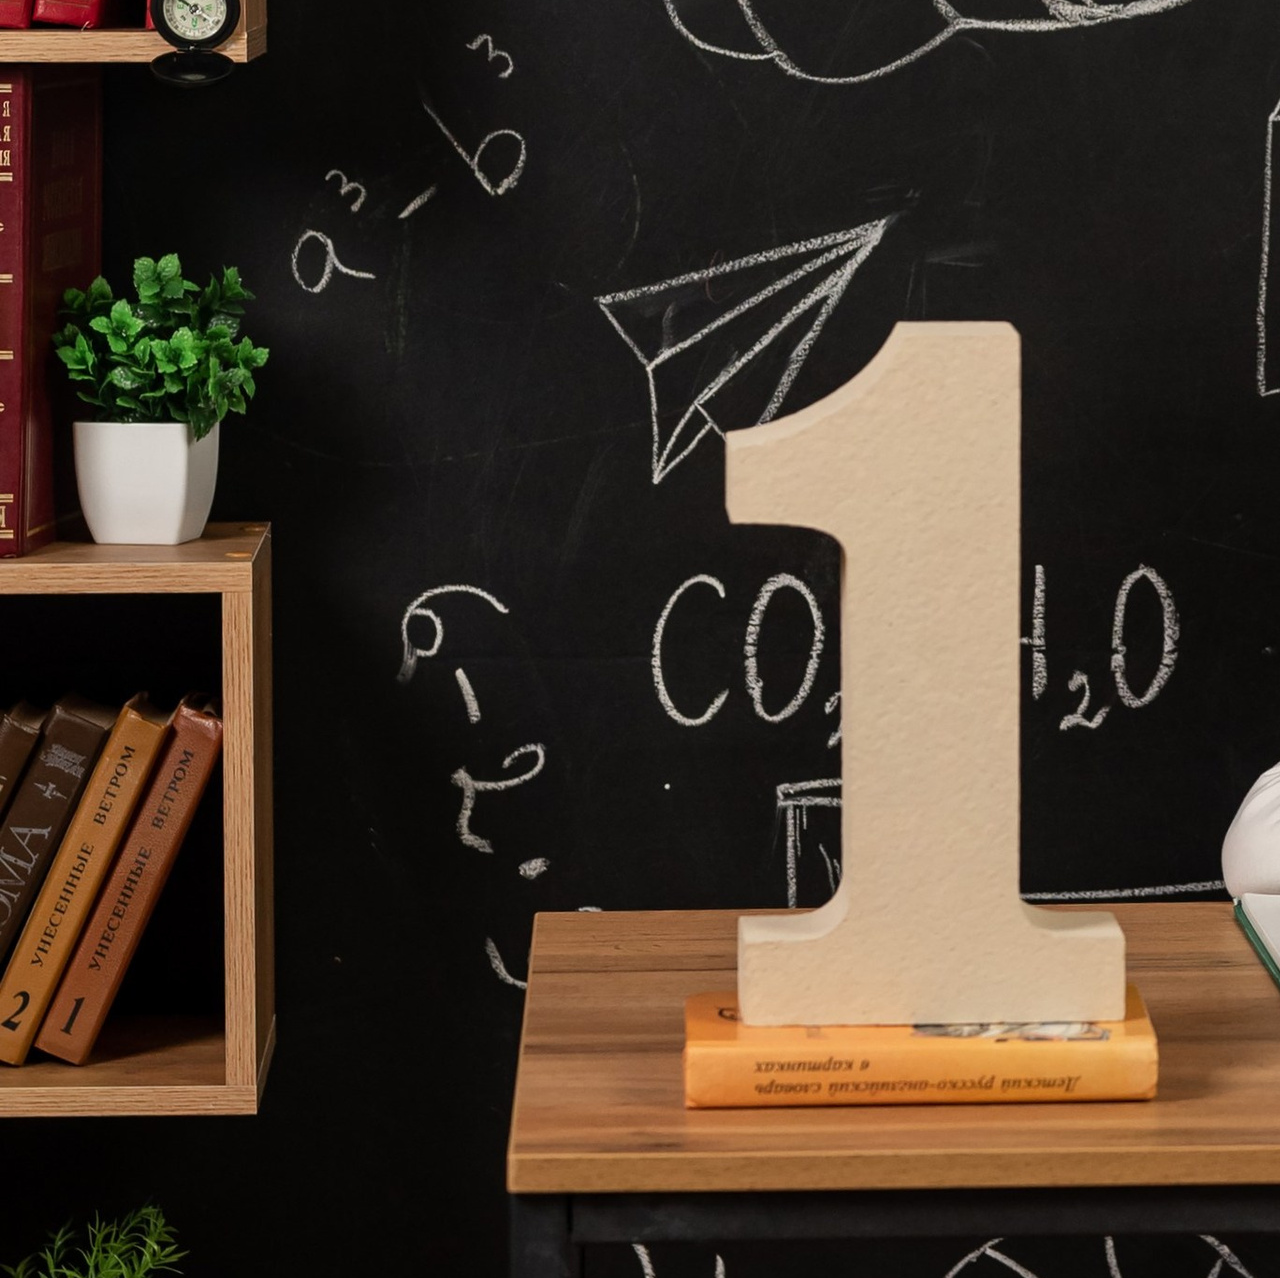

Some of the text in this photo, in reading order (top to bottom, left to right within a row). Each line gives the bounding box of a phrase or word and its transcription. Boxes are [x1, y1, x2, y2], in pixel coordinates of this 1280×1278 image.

[31, 842, 95, 968] УНЕСЕННЫЕ
[92, 745, 136, 826] ВЕТРОМ
[88, 749, 195, 973] УНЕСЕННЫЕ ВЕТРОМ
[0, 990, 31, 1032] 2
[60, 996, 86, 1036] 1
[753, 1058, 854, 1074] картинках
[753, 1078, 823, 1096] словарь
